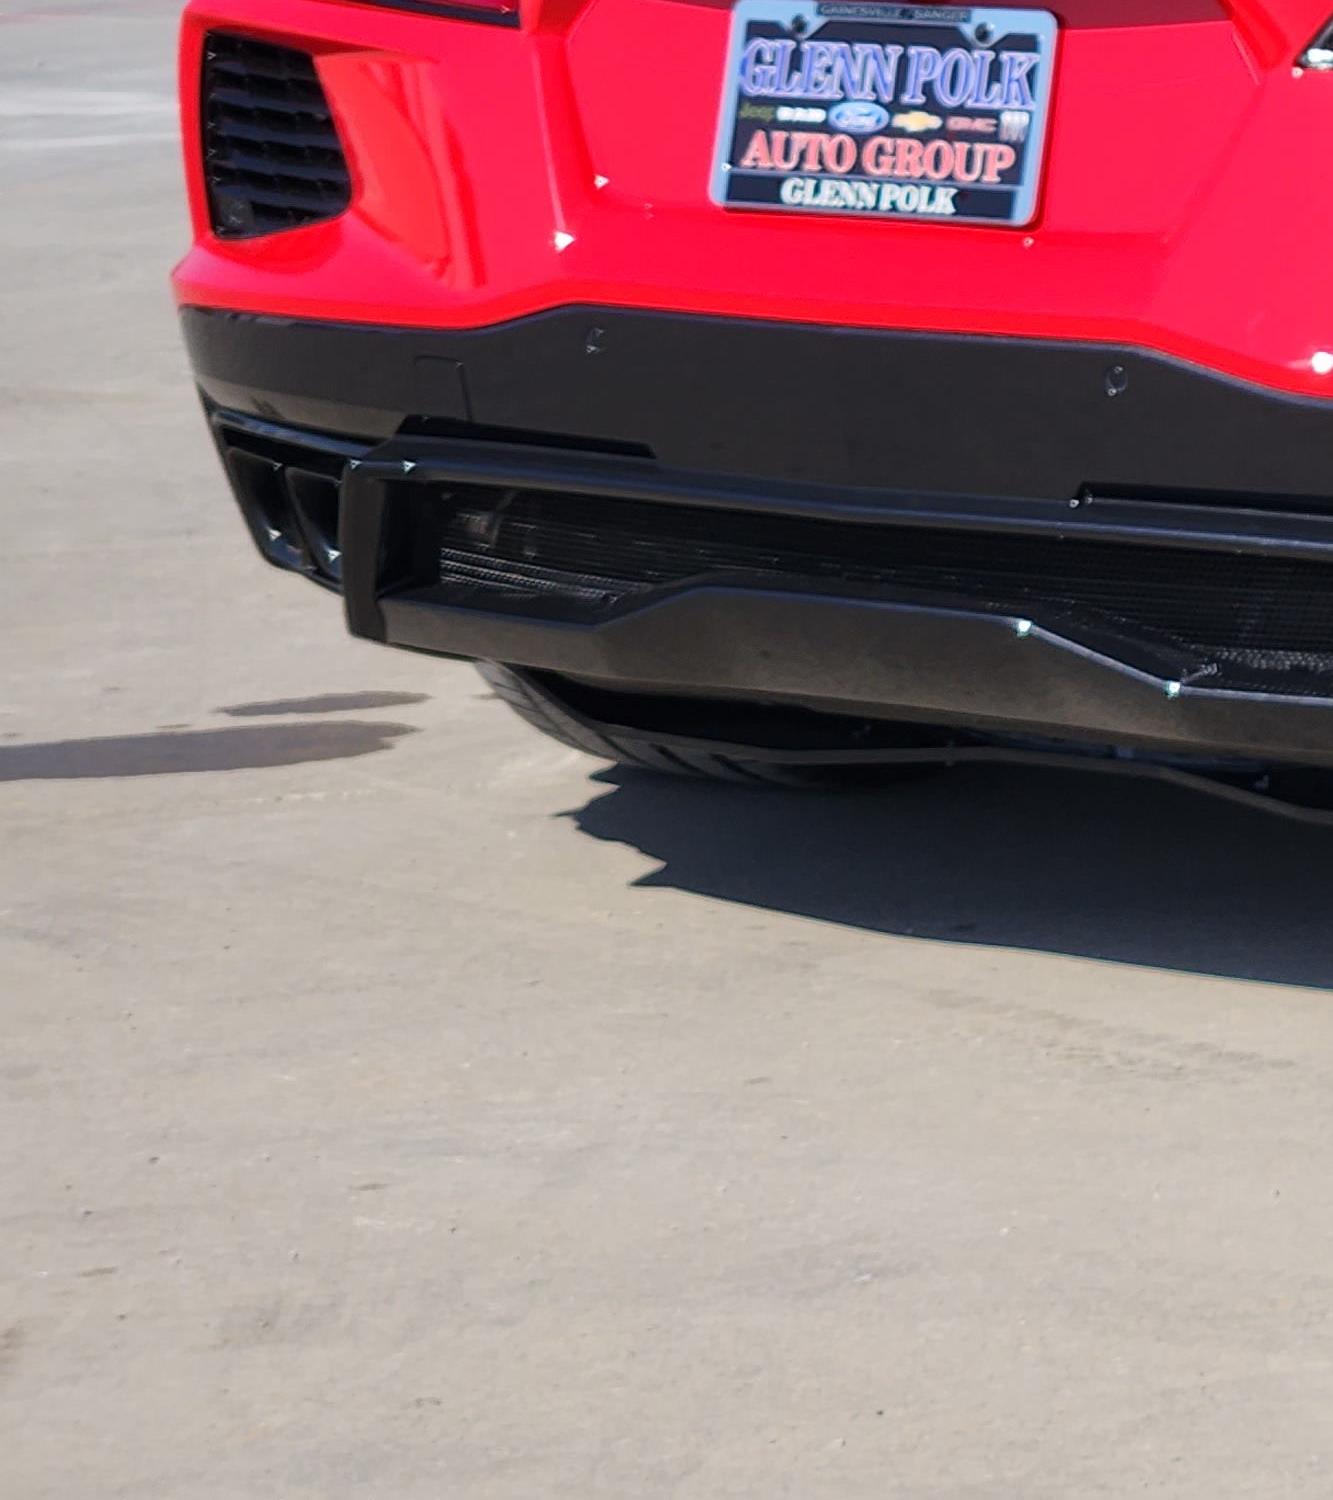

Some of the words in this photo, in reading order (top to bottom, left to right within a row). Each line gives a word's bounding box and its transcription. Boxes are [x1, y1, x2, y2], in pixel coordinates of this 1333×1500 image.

[820, 4, 901, 18] GAINESVILLE
[914, 8, 968, 21] SANGER
[740, 38, 903, 101] GLENN
[902, 46, 1040, 110] POLK
[741, 129, 857, 173] AUTO
[862, 135, 1016, 183] GROUP
[780, 178, 881, 211] GLENN
[880, 182, 958, 214] POLK
